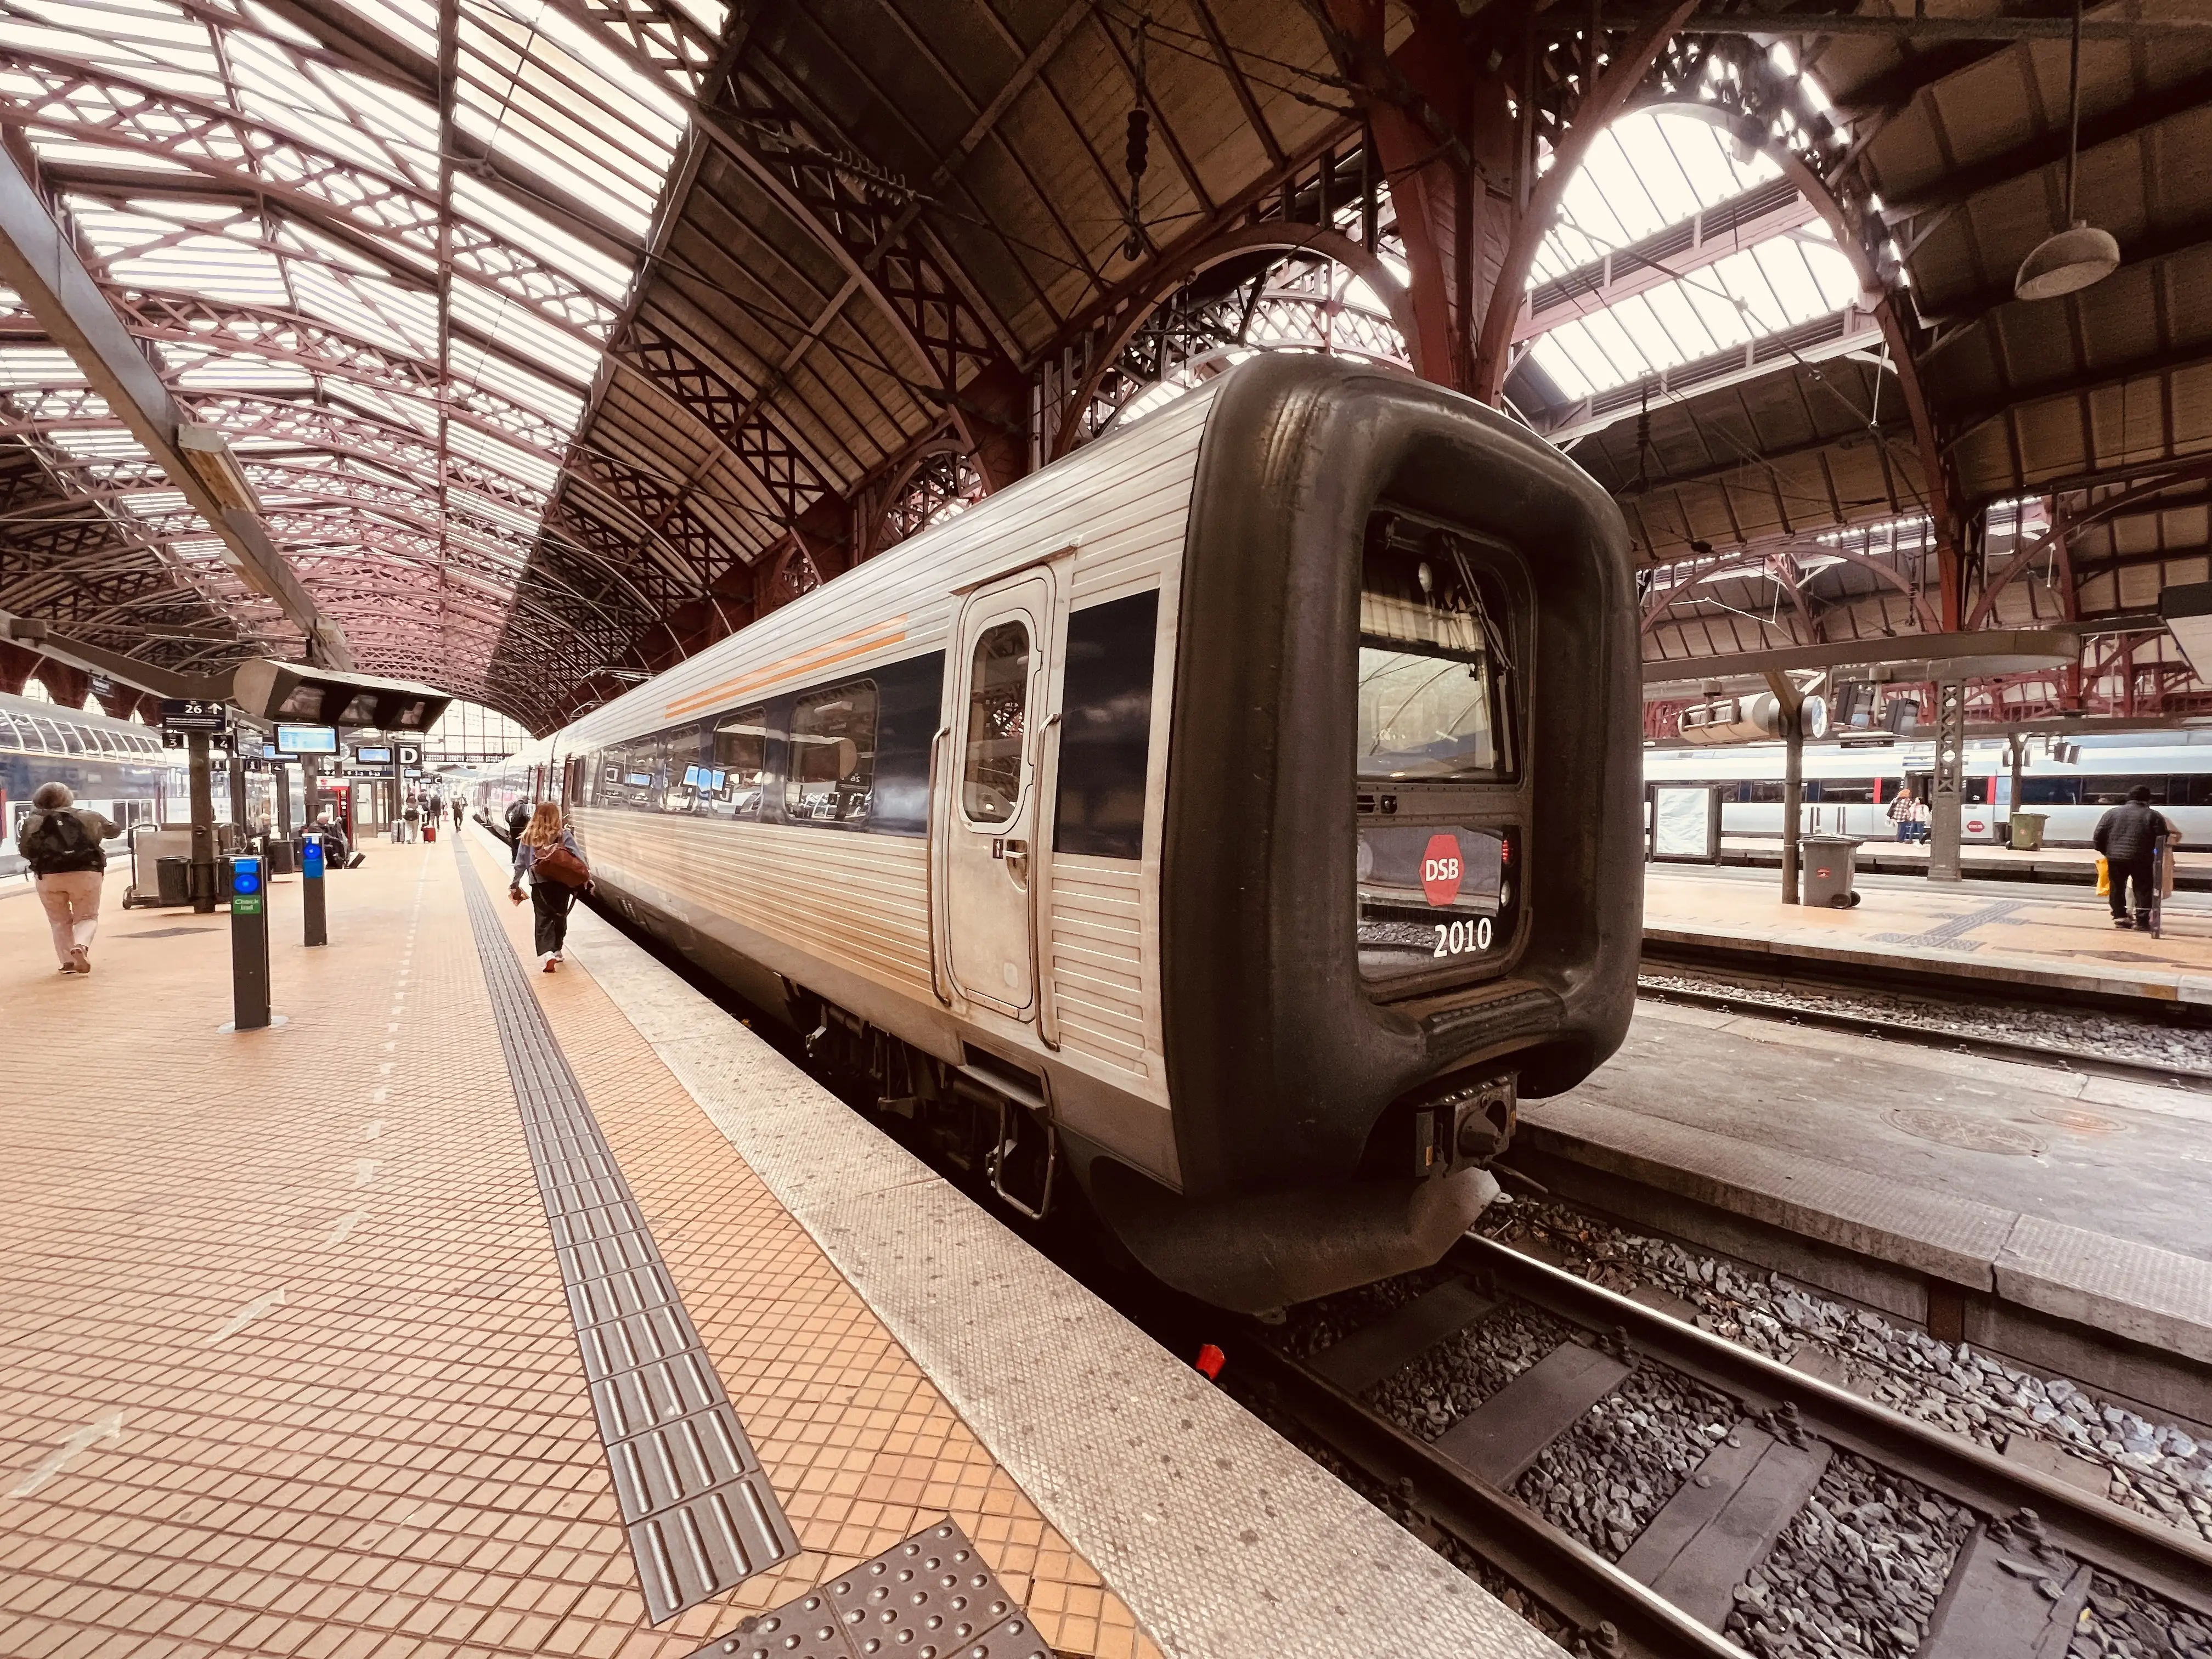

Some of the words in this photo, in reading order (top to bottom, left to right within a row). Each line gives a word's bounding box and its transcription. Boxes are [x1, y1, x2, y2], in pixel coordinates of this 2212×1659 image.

[185, 704, 202, 714] 26
[168, 738, 177, 747] 3
[220, 740, 228, 749] 4
[400, 747, 418, 764] D
[1425, 858, 1459, 882] DSB
[1433, 917, 1492, 958] 2010
